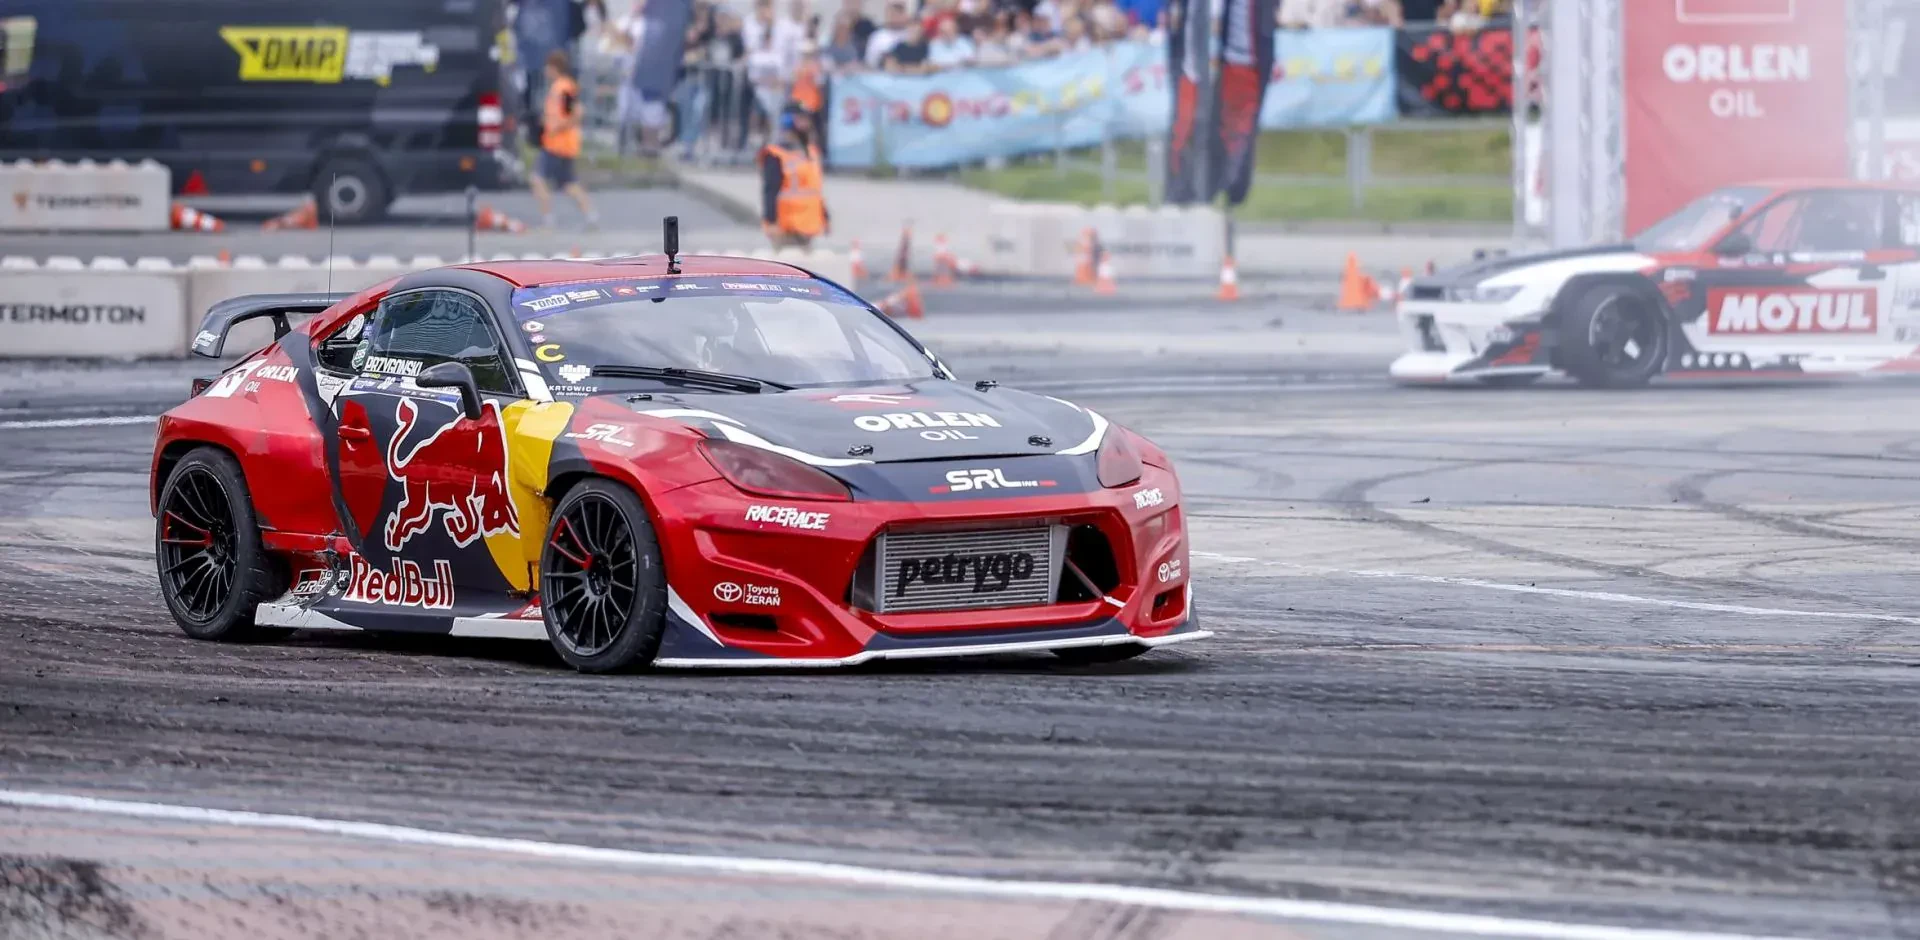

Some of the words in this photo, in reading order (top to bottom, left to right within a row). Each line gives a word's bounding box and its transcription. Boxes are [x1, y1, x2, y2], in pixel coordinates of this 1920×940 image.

[264, 39, 337, 69] DMP
[1662, 44, 1810, 82] ORLEN
[1709, 88, 1765, 118] OIL
[1715, 294, 1871, 331] MOTUL
[536, 344, 564, 361] C
[256, 366, 299, 383] ORLEN
[245, 381, 260, 393] OIL
[853, 412, 1002, 432] ORLEN
[920, 430, 979, 441] OIL
[342, 552, 400, 605] Red
[401, 559, 454, 610] Bull
[896, 552, 1034, 597] petrygo
[296, 581, 316, 593] GR
[746, 584, 779, 595] Toyota
[745, 594, 780, 605] ŻERAŃ
